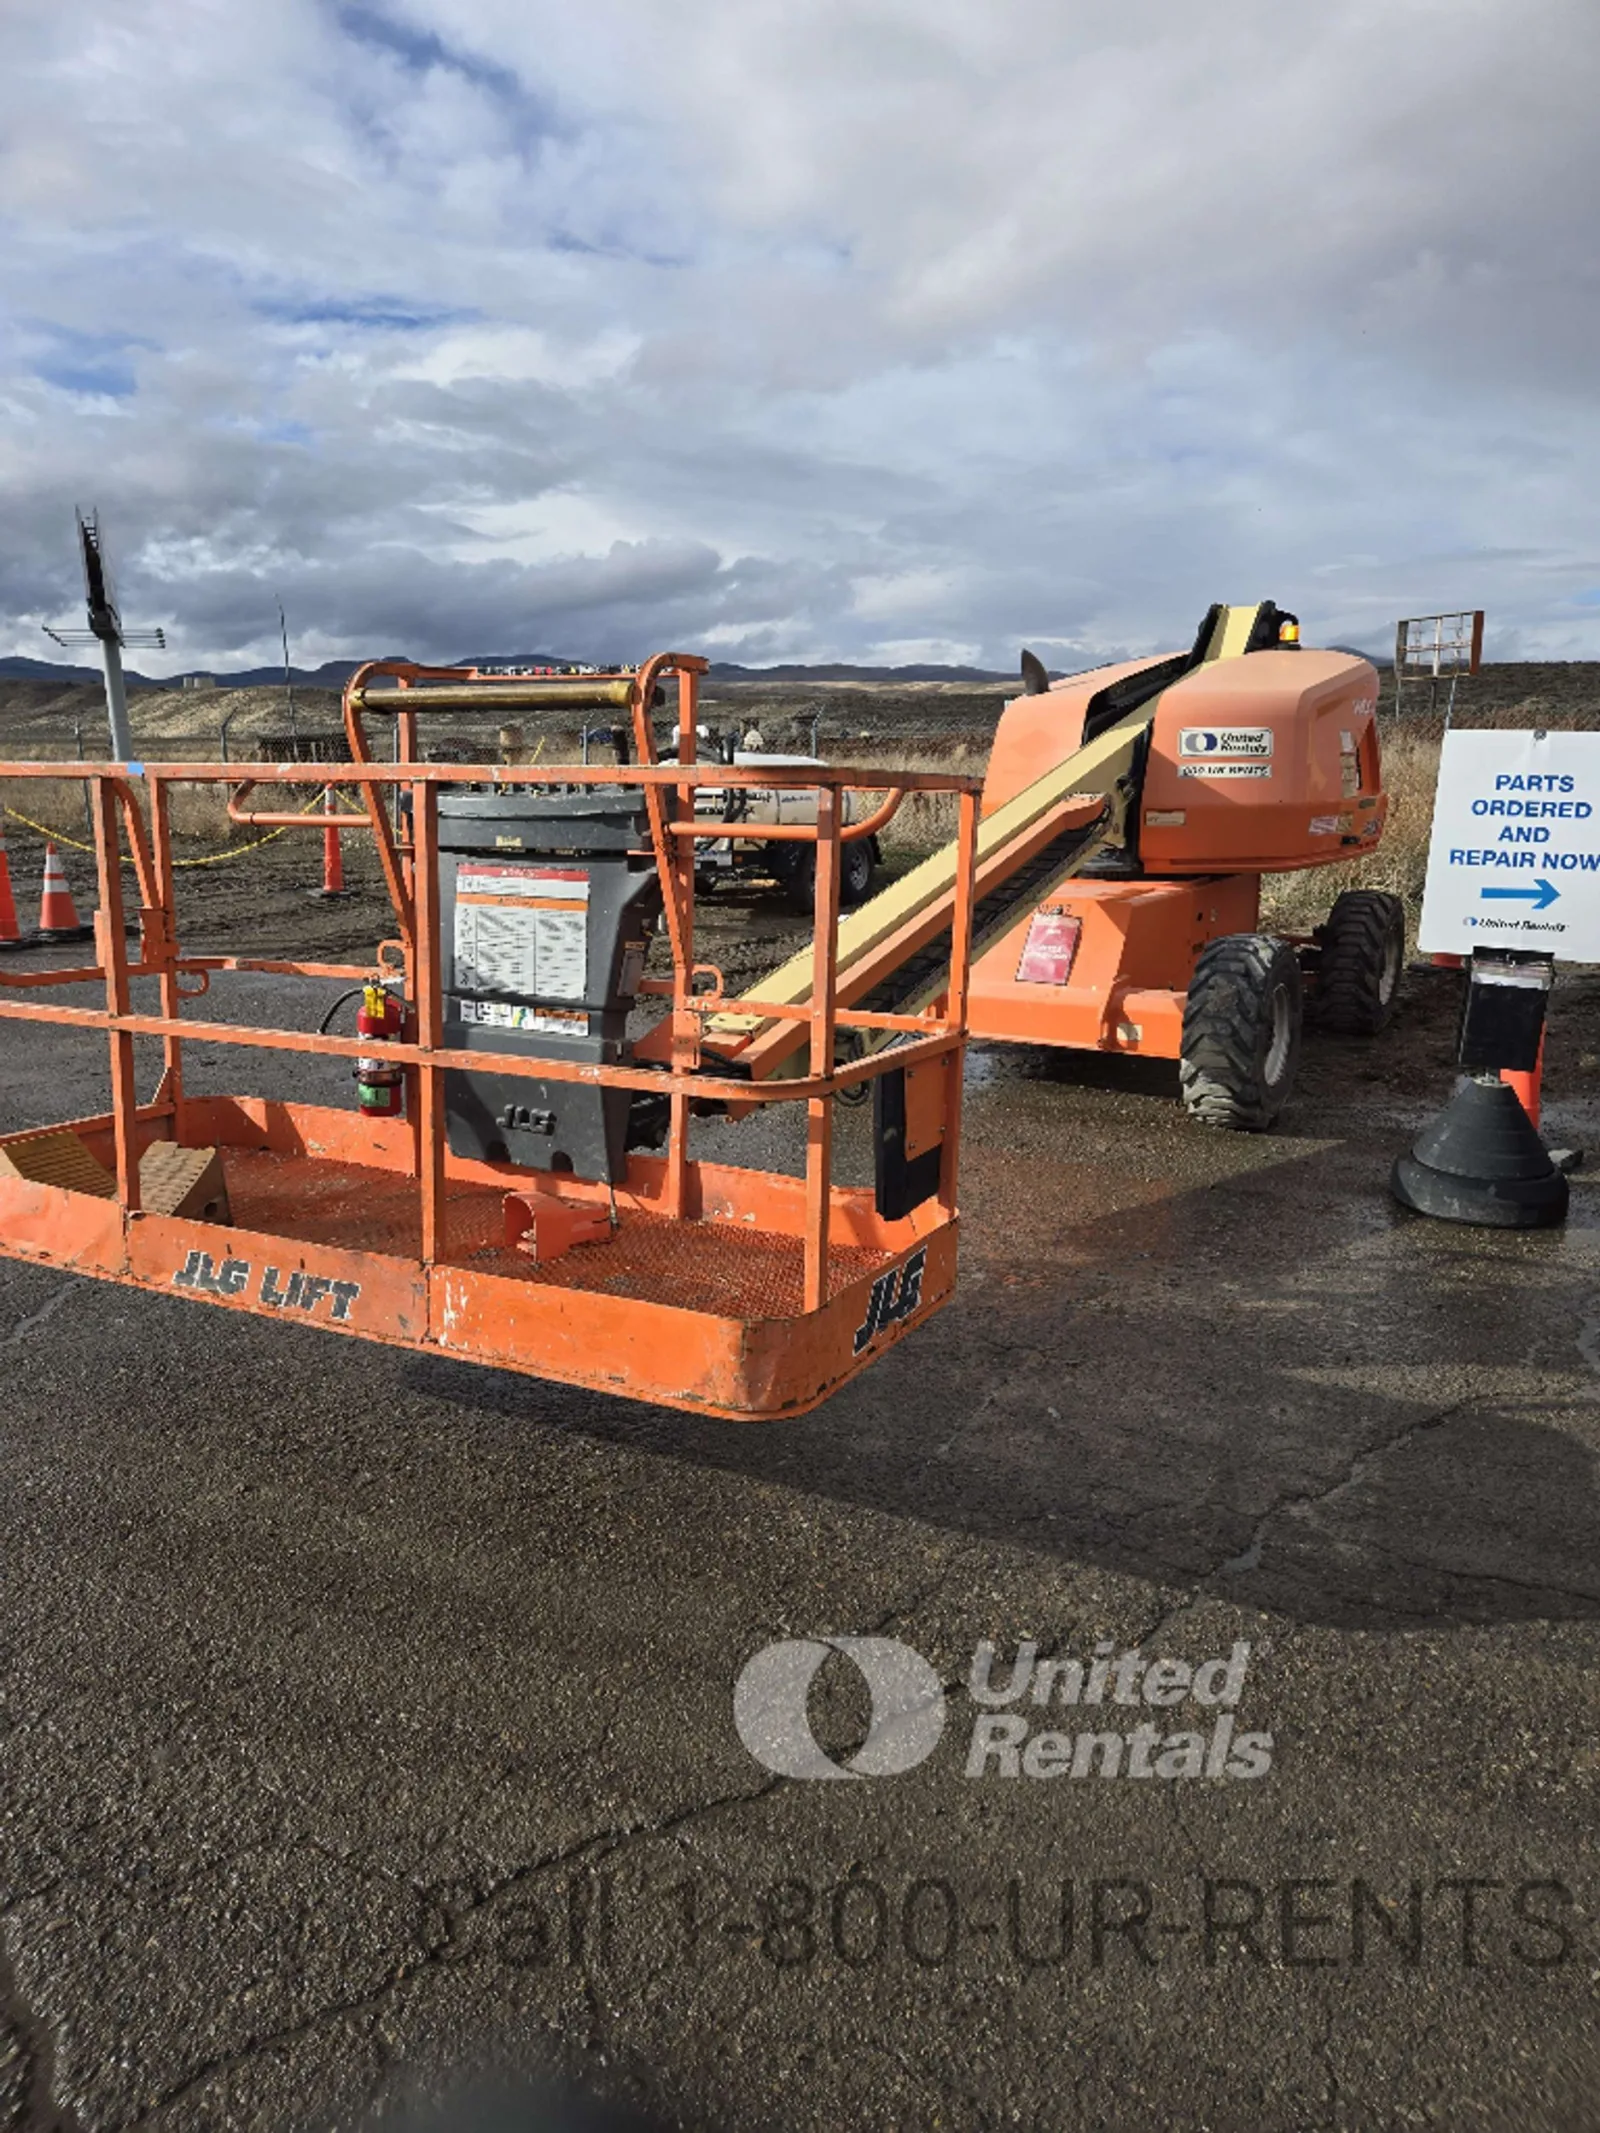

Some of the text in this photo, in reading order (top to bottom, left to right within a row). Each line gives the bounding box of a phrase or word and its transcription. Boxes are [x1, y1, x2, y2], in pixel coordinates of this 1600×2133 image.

[1495, 774, 1575, 793] PARTS
[1471, 799, 1593, 819] ORDERED
[1498, 826, 1550, 843] AND
[1450, 849, 1600, 871] REPAIR NOW
[496, 1104, 557, 1136] JLG
[173, 1249, 362, 1320] JLG LIFT
[853, 1244, 928, 1357] JLG
